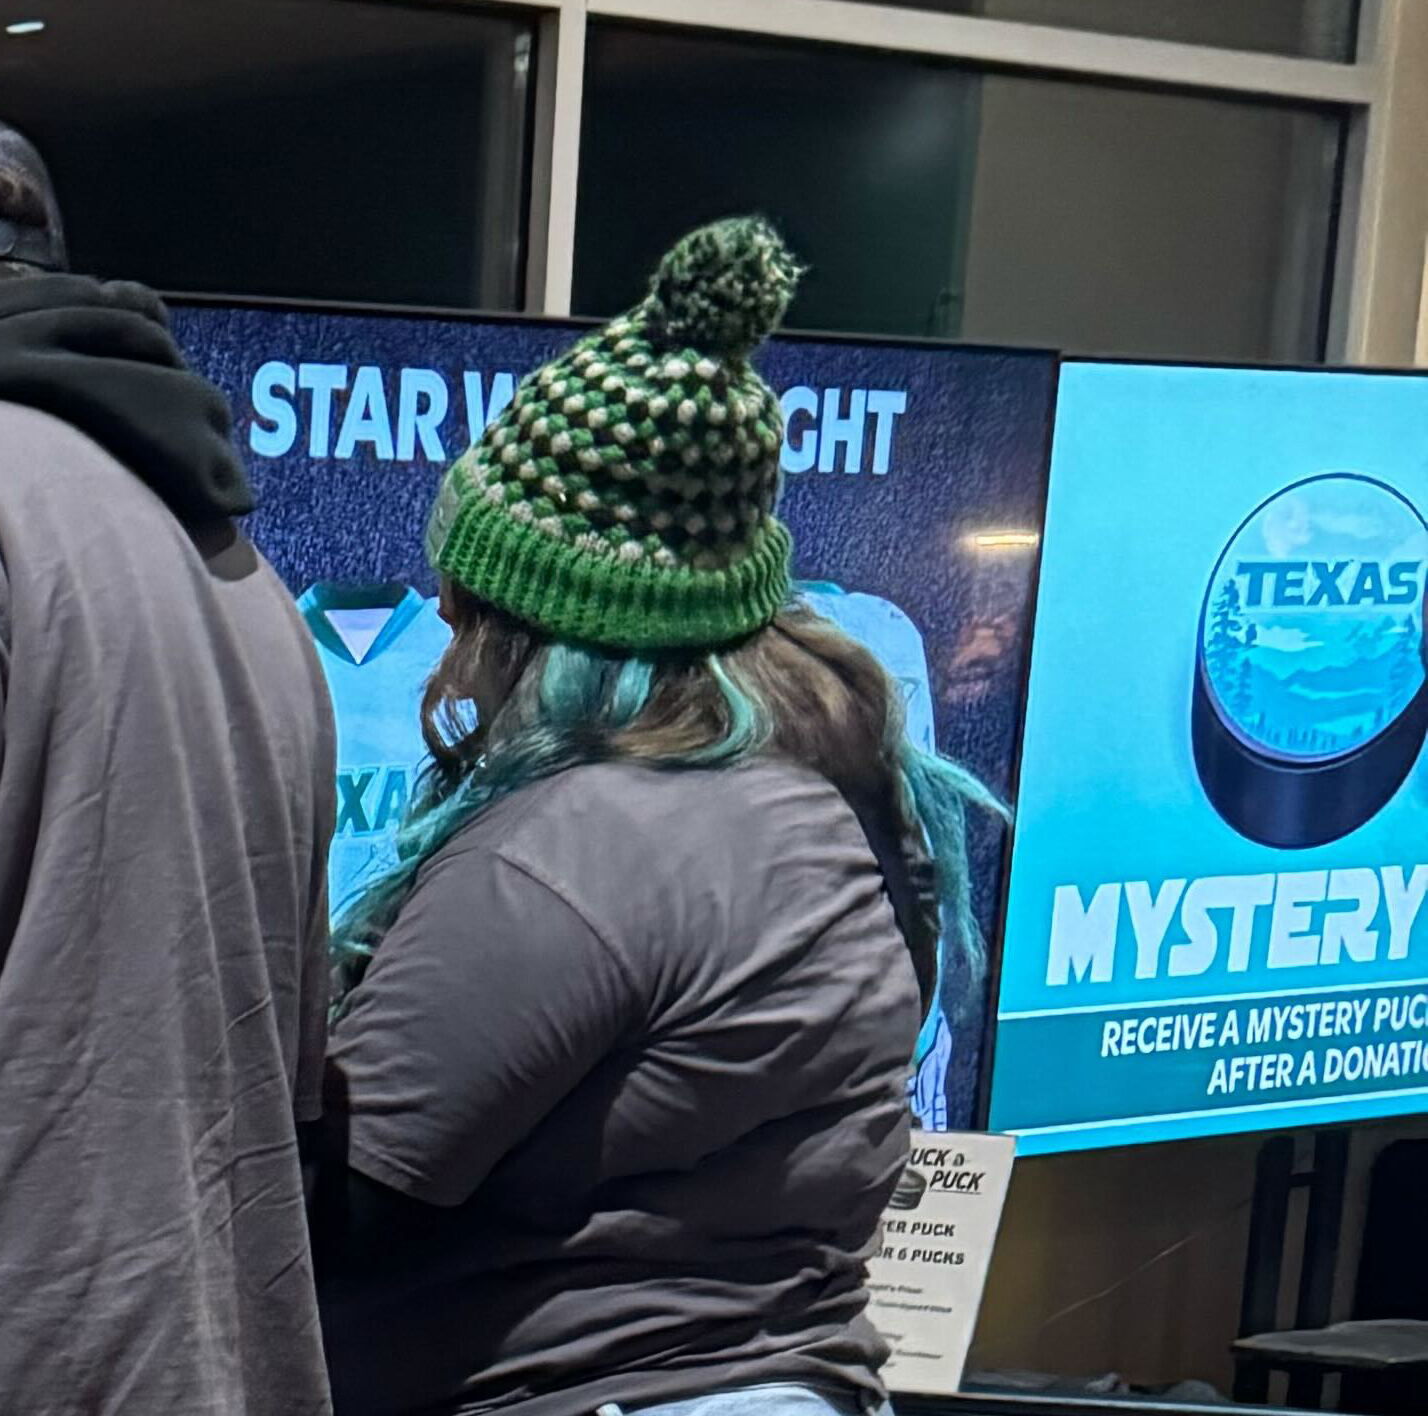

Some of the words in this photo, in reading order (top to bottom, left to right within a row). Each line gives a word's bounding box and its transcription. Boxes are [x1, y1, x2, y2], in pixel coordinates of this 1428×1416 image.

[250, 361, 448, 463] STAR
[779, 385, 907, 475] GHT
[1236, 561, 1420, 605] TEXAS
[1046, 864, 1428, 986] MYSTERY
[1101, 1012, 1217, 1057] RECEIVE
[1218, 1009, 1240, 1047] A
[1246, 998, 1370, 1044] MYSTERY
[1373, 993, 1428, 1032] PUC
[1207, 1053, 1294, 1095] AFTER
[1296, 1050, 1316, 1086] A
[1323, 1040, 1428, 1083] DONATI
[910, 1148, 952, 1167] UCK
[929, 1170, 985, 1190] PUCK
[885, 1220, 907, 1234] ER
[911, 1222, 955, 1237] PUCK
[910, 1249, 965, 1265] PUCKS
